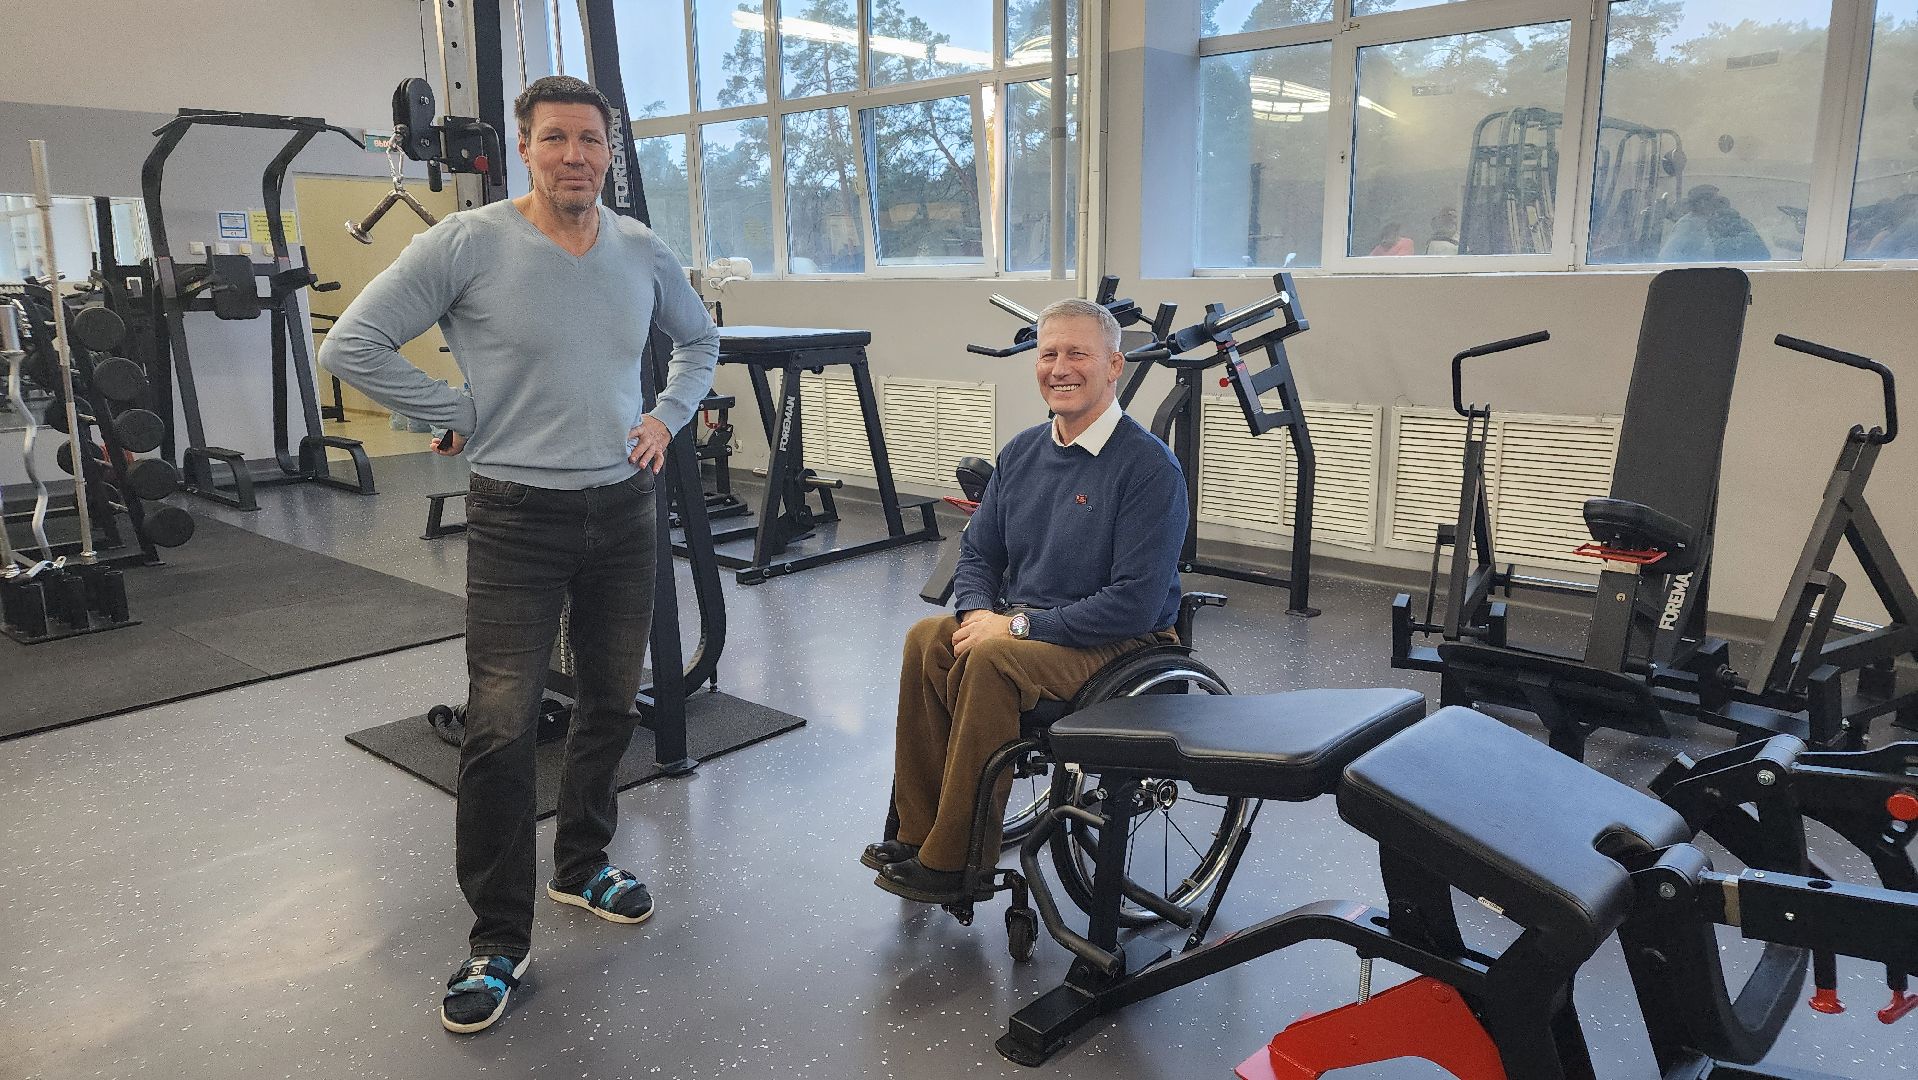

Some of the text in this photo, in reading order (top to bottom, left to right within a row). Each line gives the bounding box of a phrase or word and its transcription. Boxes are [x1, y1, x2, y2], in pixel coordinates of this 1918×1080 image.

[610, 107, 631, 208] FOREMAN
[779, 395, 796, 451] FOREMAN
[1659, 571, 1694, 631] FOREMA
